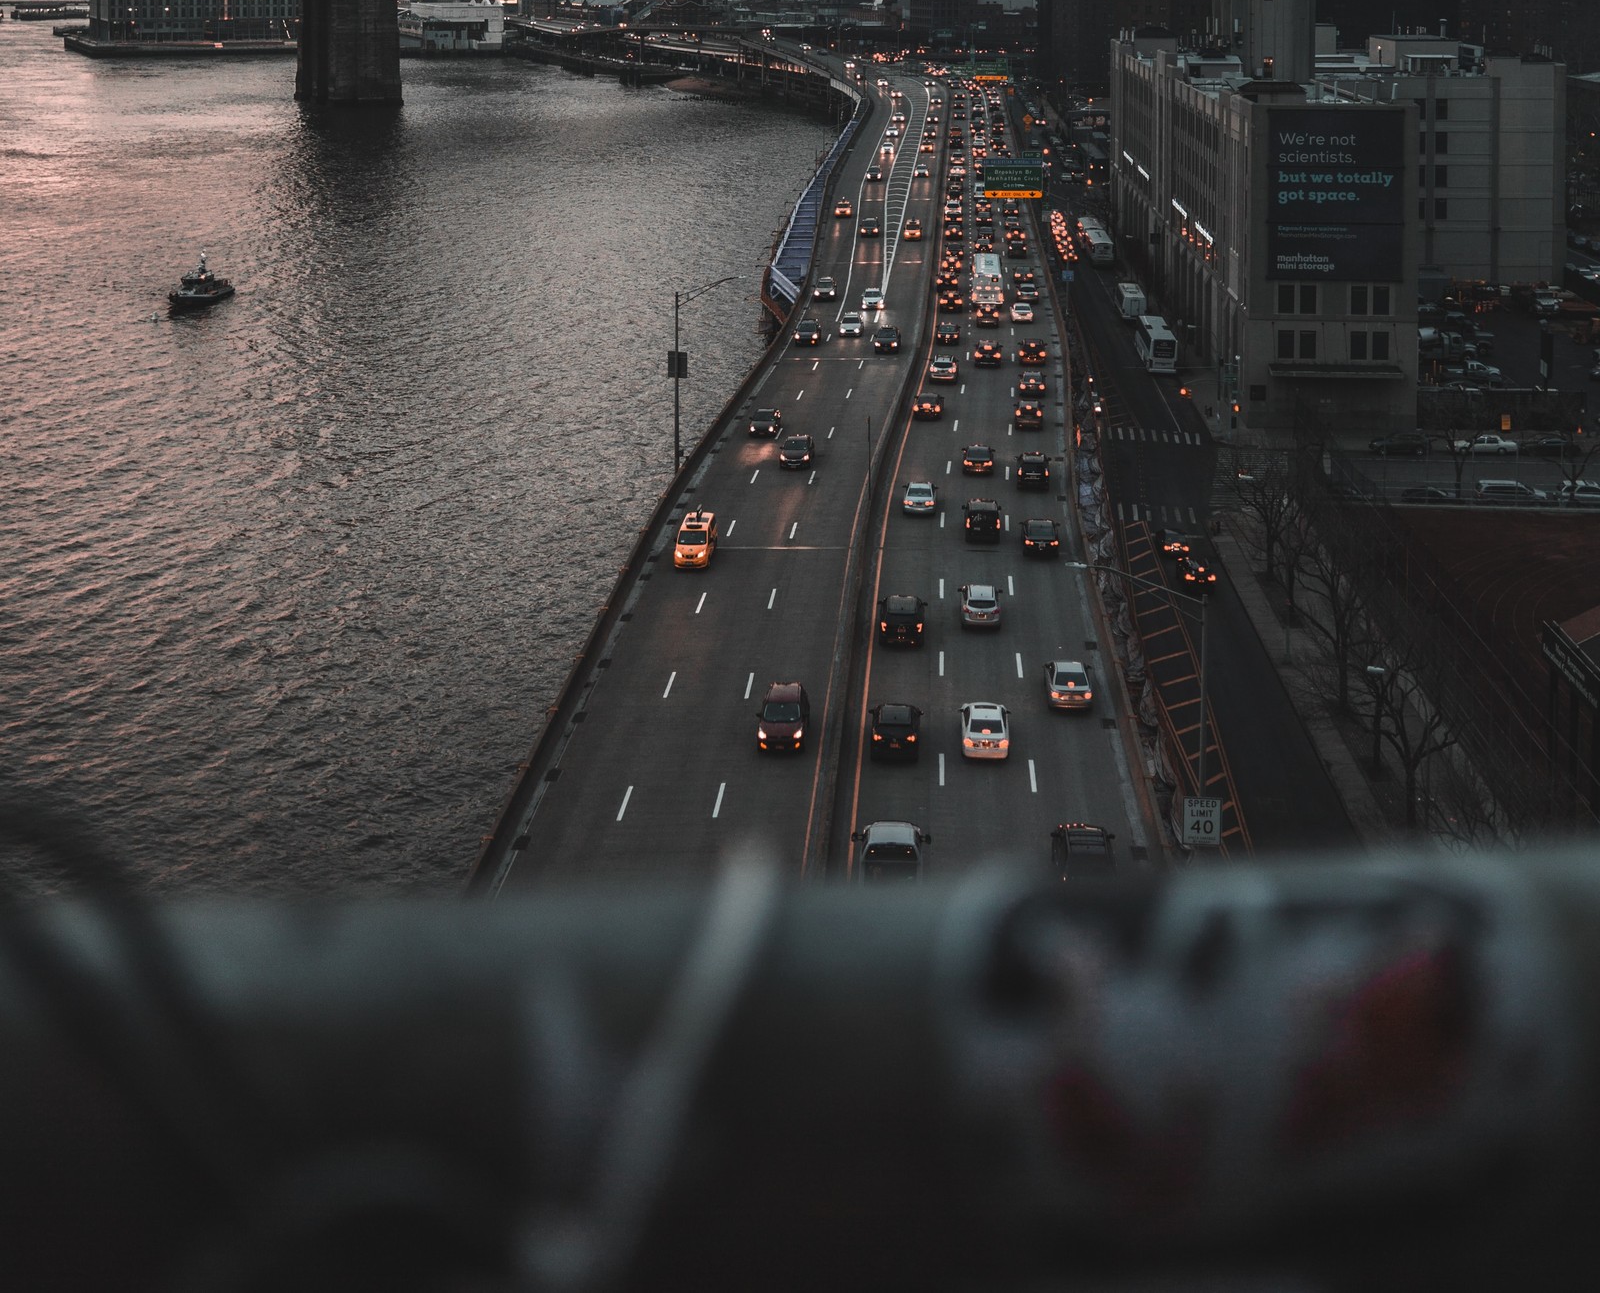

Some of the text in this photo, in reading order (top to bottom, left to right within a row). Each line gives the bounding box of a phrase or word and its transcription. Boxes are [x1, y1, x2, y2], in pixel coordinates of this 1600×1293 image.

[1279, 132, 1356, 146] We're not
[1278, 170, 1394, 187] but we totally
[1278, 189, 1360, 204] got space.
[1277, 252, 1329, 263] manhattan
[1277, 262, 1335, 272] mini storage
[1188, 799, 1217, 808] SPEED
[1191, 820, 1213, 834] 40
